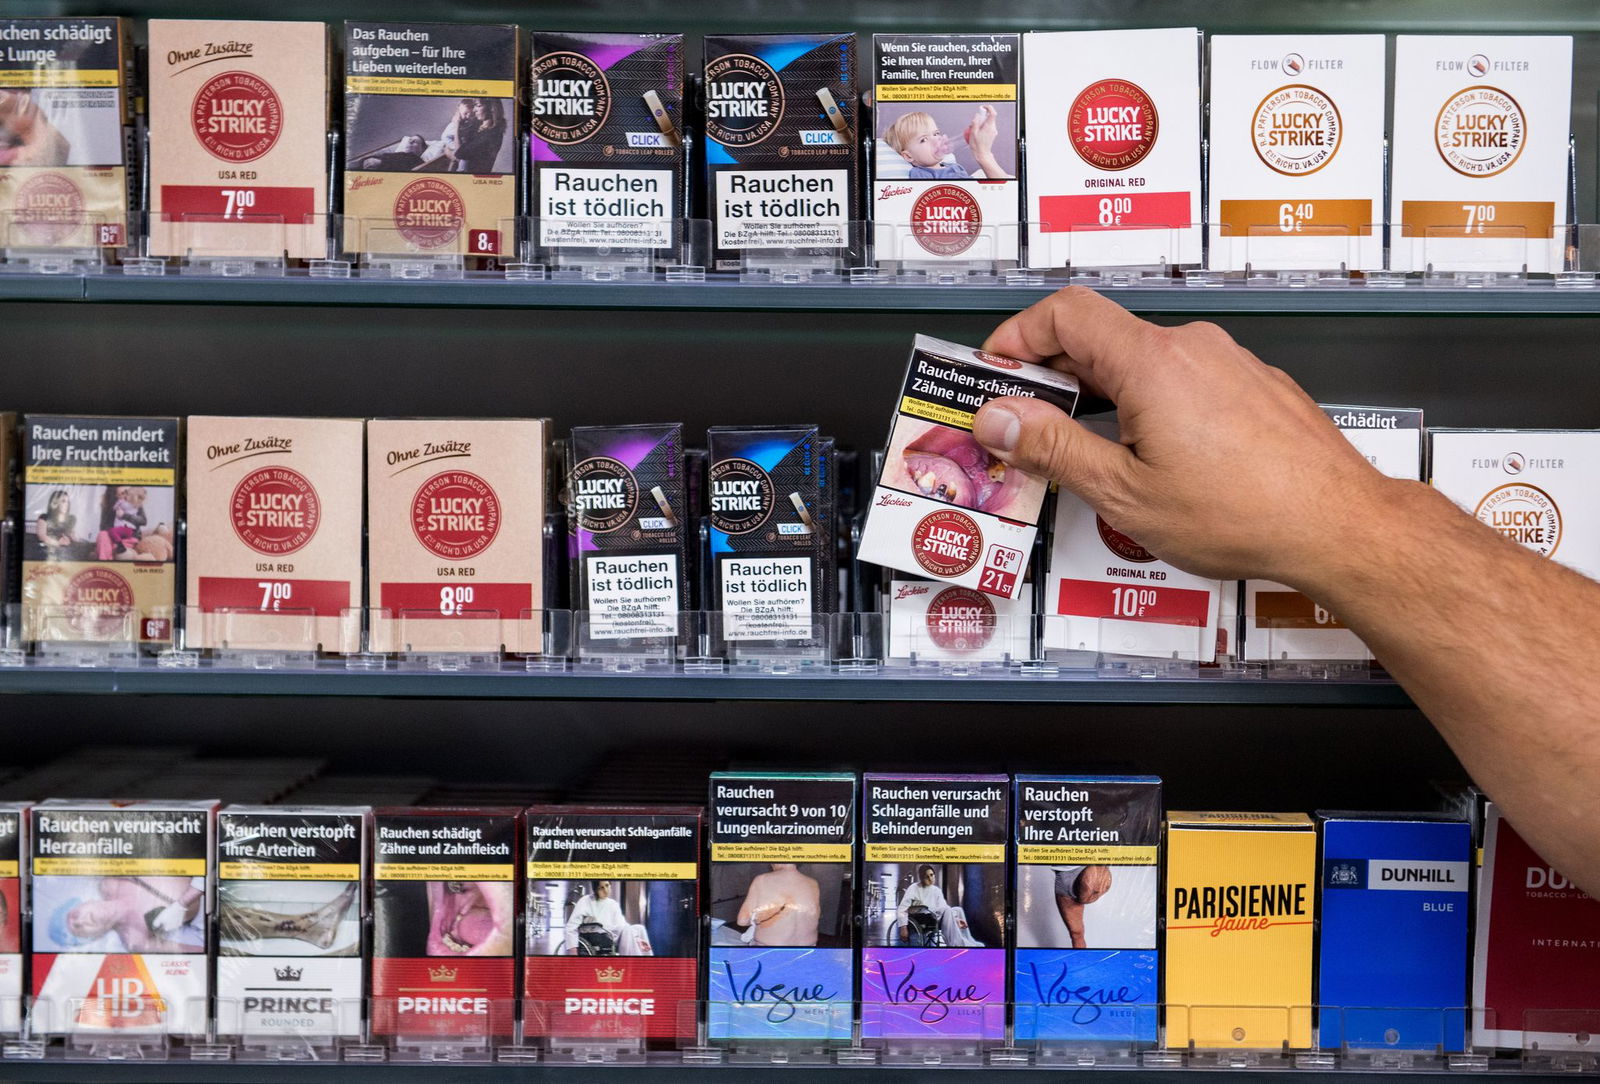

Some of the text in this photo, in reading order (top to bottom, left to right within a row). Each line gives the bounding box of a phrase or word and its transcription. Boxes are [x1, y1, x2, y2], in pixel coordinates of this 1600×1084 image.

[44, 24, 112, 44] schädigt
[353, 28, 429, 41] Das Rauchen
[8, 47, 56, 65] Lunge
[167, 41, 253, 65] Ohne Zusätze
[353, 45, 466, 59] aufgeben für Ihre
[881, 42, 1011, 54] Wenn Sie rauchen, schaden
[353, 61, 466, 75] Lieben weiterleben
[881, 56, 992, 67] Sie Ihren Kindern, Ihrer
[1251, 60, 1343, 70] FLOW FILTER
[1436, 61, 1529, 71] FLOW FILTER
[881, 69, 994, 80] Familie, Ihren Freunden
[537, 79, 592, 97] LUCKY
[711, 82, 766, 100] LUCKY
[211, 99, 265, 116] LUCKY
[534, 99, 594, 116] STRIKE
[708, 100, 768, 118] STRIKE
[1086, 106, 1140, 123] LUCKY
[208, 117, 266, 134] STRIKE
[1272, 113, 1323, 129] LUCKY
[1294, 90, 1336, 148] TOBACCO COMPANY
[1456, 114, 1508, 130] LUCKY
[631, 135, 660, 146] CLICK
[805, 132, 834, 144] CLICK
[1084, 124, 1142, 142] STRIKE
[1268, 130, 1324, 146] STRIKE
[1452, 132, 1508, 148] STRIKE
[1314, 149, 1329, 164] USA
[218, 171, 258, 180] USA RED
[555, 173, 658, 192] Rauchen
[731, 174, 834, 193] Rauchen
[1085, 177, 1146, 188] ORIGINAL RED
[878, 185, 913, 200] Luckies
[409, 199, 452, 213] LUCKY
[549, 198, 664, 217] ist tödlich
[725, 199, 840, 217] ist tödlich
[925, 206, 968, 220] LUCKY
[406, 213, 452, 226] STRIKE
[923, 220, 969, 234] STRIKE
[917, 360, 976, 387] Rauchen
[911, 377, 985, 408] Zähne und
[32, 424, 164, 442] Rauchen mindert
[32, 444, 170, 463] Ihre Fruchtbarkeit
[207, 436, 293, 460] Ohne Zusätze
[387, 441, 471, 465] Ohne Zusätze
[1472, 459, 1564, 469] FLOW FILTER
[577, 479, 624, 494] LUCKY
[713, 481, 759, 496] LUCKY
[250, 493, 303, 510] LUCKY
[430, 498, 483, 514] LUCKY
[575, 494, 626, 510] STRIKE
[711, 496, 761, 511] STRIKE
[876, 494, 913, 507] Luckies
[246, 510, 305, 528] STRIKE
[427, 515, 485, 532] STRIKE
[643, 520, 664, 528] CLICK
[1492, 511, 1543, 526] LUCKY
[781, 525, 802, 534] CLICK
[928, 525, 972, 547] LUCKY
[922, 538, 969, 561] STRIKE
[256, 563, 294, 573] USA RED
[437, 567, 475, 577] USA RED
[595, 560, 669, 574] Rauchen
[730, 562, 803, 576] Rauchen
[1106, 567, 1167, 581] ORIGINAL RED
[592, 576, 673, 591] ist tödlich
[726, 579, 807, 593] ist tödlich
[767, 598, 805, 606] aufhören?
[717, 785, 774, 799] Rauchen
[872, 786, 1001, 801] Rauchen verursacht
[1025, 786, 1089, 802] Rauchen
[717, 804, 846, 817] verursacht 9 von 10
[872, 804, 989, 820] Schlaganfälle und
[1024, 806, 1093, 825] verstopft
[39, 816, 201, 834] Rauchen verursacht
[226, 823, 356, 841] Rauchen verstopft
[533, 826, 693, 839] Rauchen verursacht Schlaganfälle
[717, 821, 844, 837] Lungenkarzinomen
[872, 821, 973, 838] Behinderungen
[380, 826, 482, 842] Rauchen schädigt
[1024, 825, 1119, 842] Ihre Arterien
[39, 838, 133, 855] Herzanfälle
[225, 842, 315, 857] Ihre Arterien
[380, 842, 510, 855] Zähne und Zahnfleisch
[533, 840, 627, 852] und Behinderungen
[1381, 867, 1455, 883] DUNHILL
[1174, 884, 1306, 919] PARISIENNE
[1423, 903, 1454, 912] BLUE
[1210, 914, 1272, 937] Jaune
[97, 978, 145, 1017] HB
[723, 960, 838, 1024] Vogue
[877, 960, 992, 1024] Vogue
[1030, 961, 1144, 1025] Vogue
[244, 997, 333, 1013] PRINCE
[398, 997, 488, 1014] PRINCE
[564, 998, 655, 1015] PRINCE
[261, 1018, 314, 1027] ROUNDED
